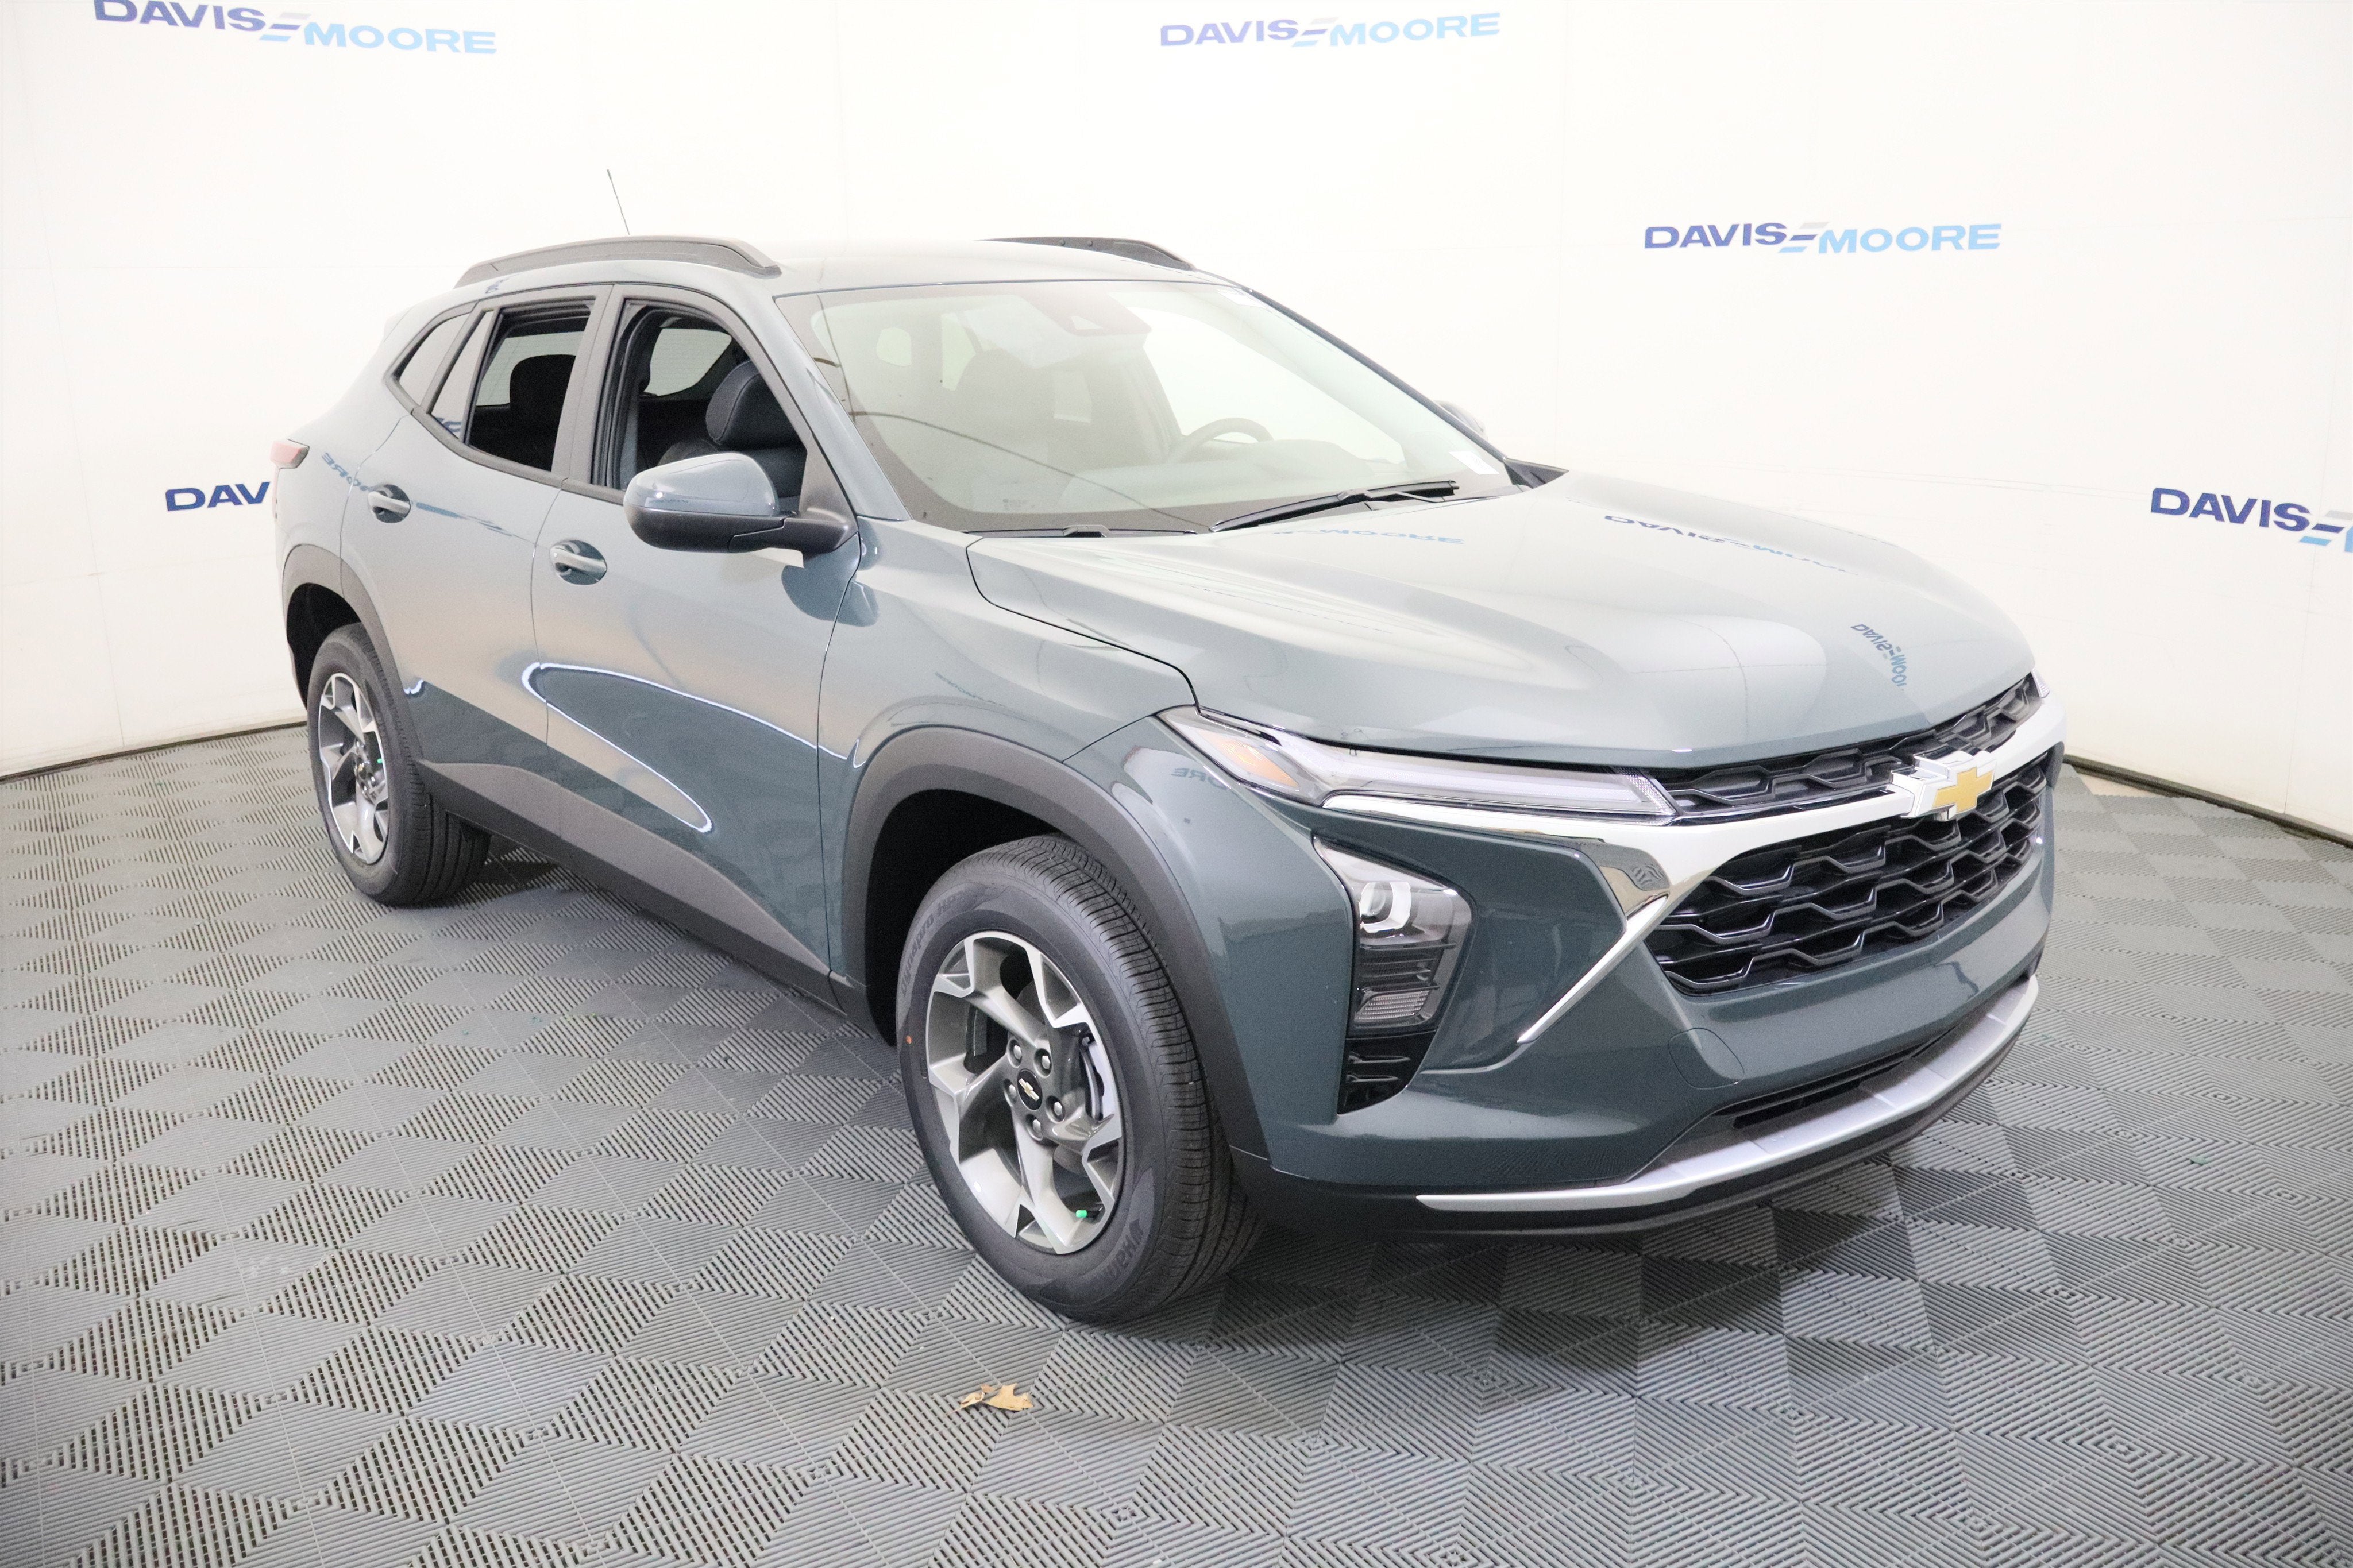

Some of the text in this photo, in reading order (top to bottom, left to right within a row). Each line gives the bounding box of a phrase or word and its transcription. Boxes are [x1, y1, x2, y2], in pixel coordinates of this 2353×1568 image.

[94, 0, 497, 55] DAVIS MOORE
[1161, 13, 1501, 47] DAVIS MOORE
[1645, 223, 2003, 254] DAVIS MOORE
[166, 482, 271, 512] DAV
[2151, 488, 2310, 532] DAVIS
